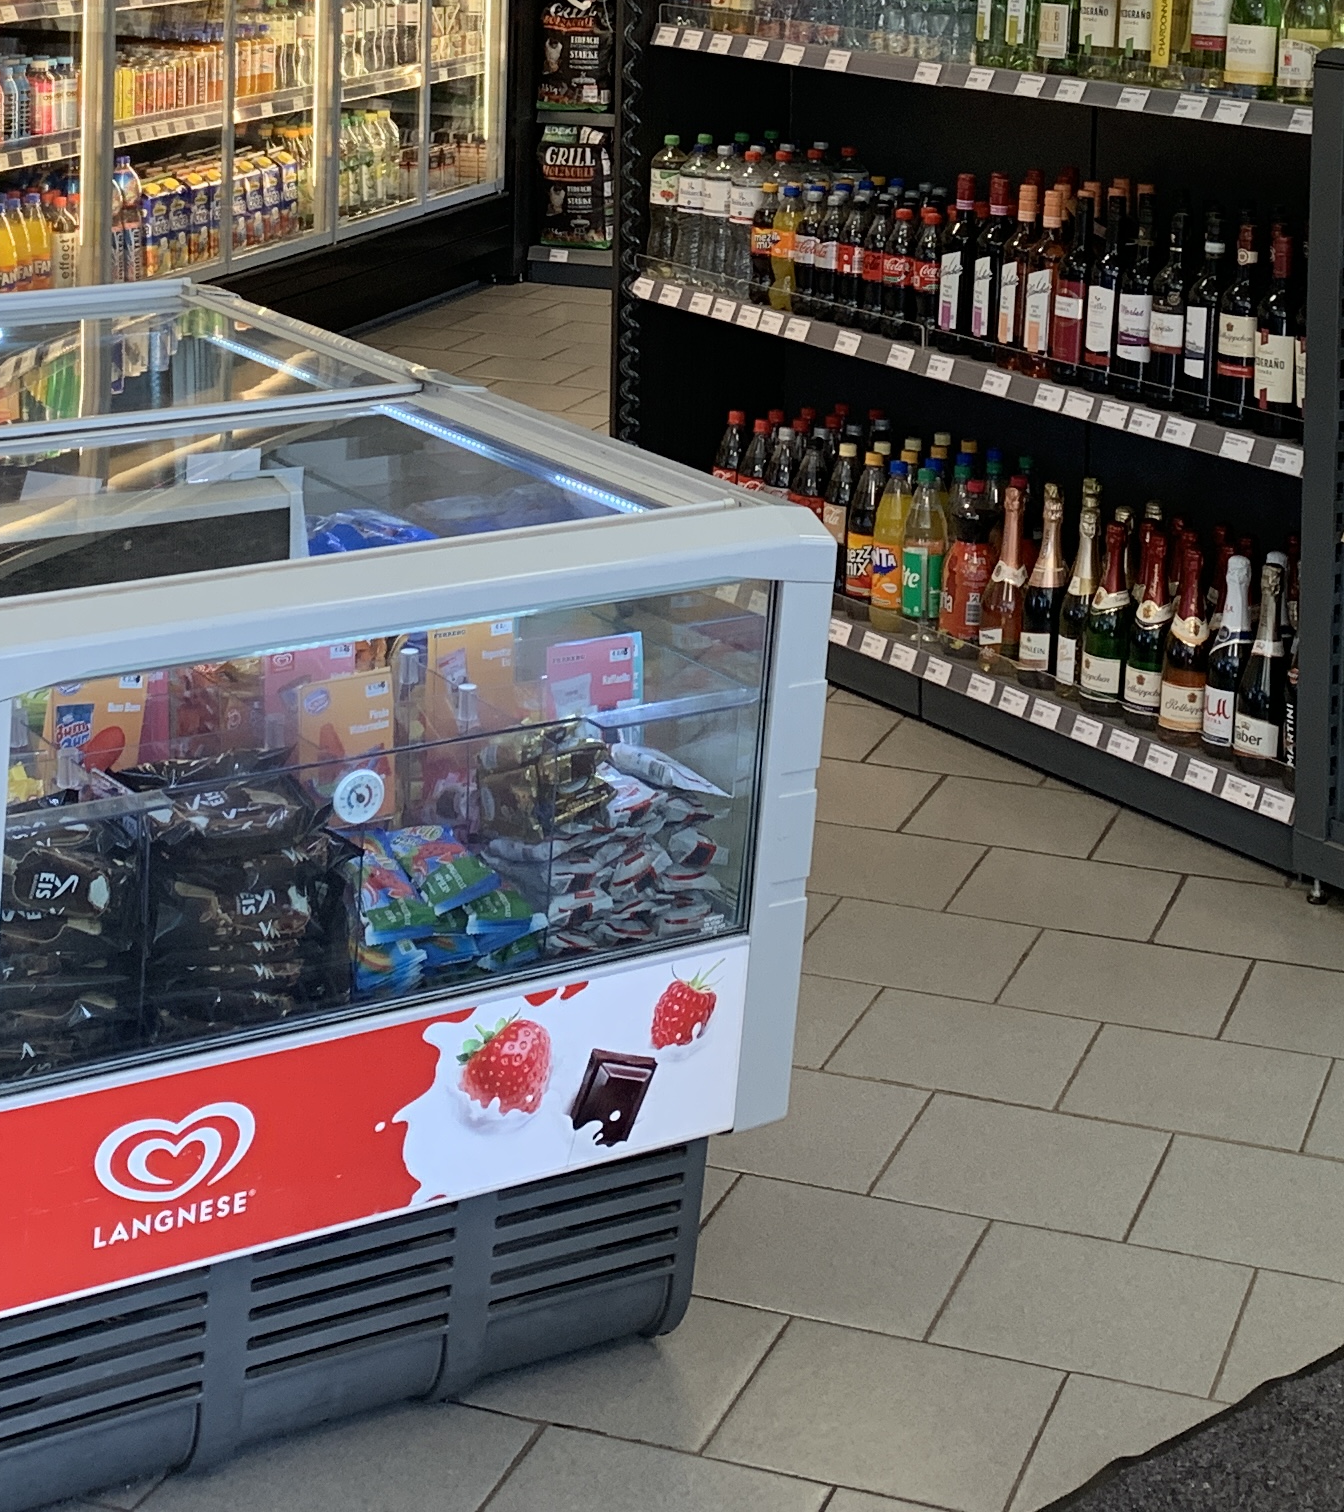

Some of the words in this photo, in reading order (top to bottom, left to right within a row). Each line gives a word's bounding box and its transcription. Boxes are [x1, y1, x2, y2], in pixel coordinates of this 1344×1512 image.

[545, 146, 596, 166] GRILL
[57, 238, 70, 279] effect
[871, 547, 897, 567] NTA
[903, 563, 920, 588] ite
[1234, 725, 1263, 746] aber
[1285, 703, 1295, 767] MARTINI
[39, 871, 55, 901] EIS
[240, 891, 256, 916] EIS
[93, 1191, 249, 1249] LANGNESE
